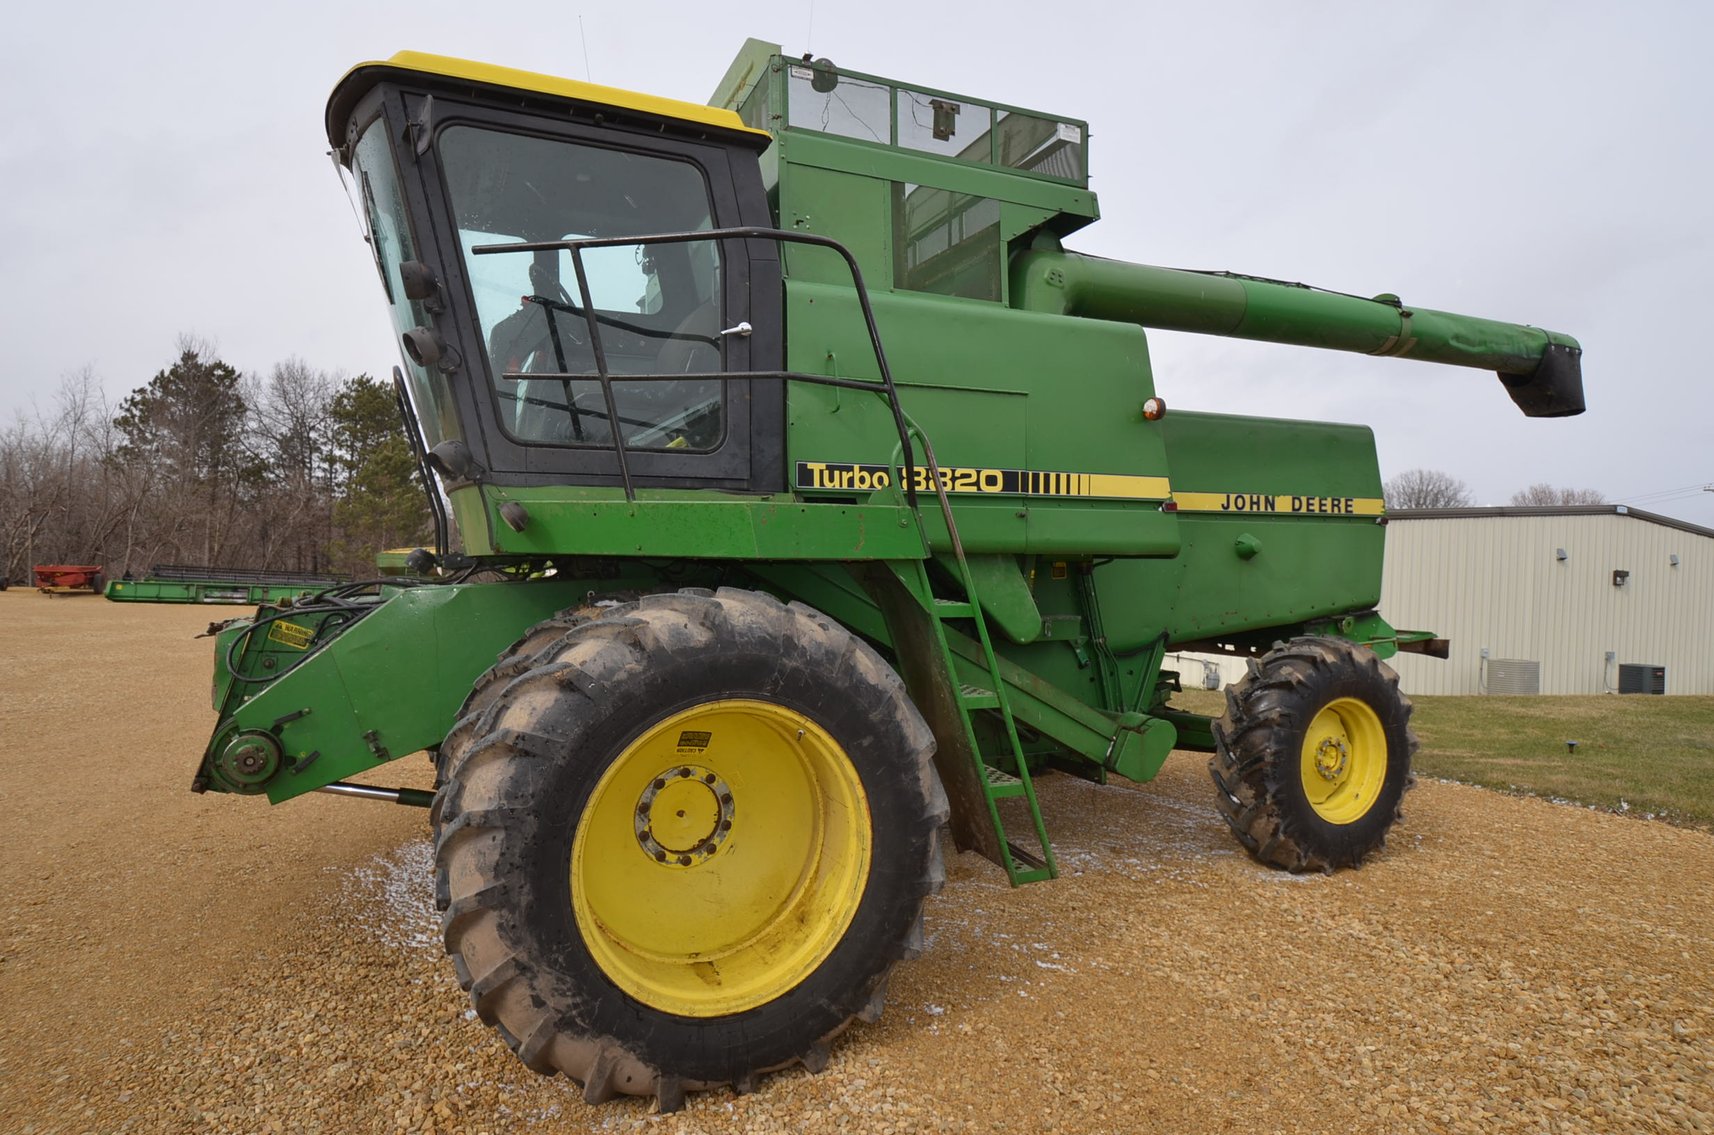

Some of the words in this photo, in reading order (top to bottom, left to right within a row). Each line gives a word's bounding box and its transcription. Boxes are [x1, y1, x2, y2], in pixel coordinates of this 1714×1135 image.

[807, 463, 889, 489] Turbo
[902, 466, 1003, 492] 8820
[1221, 494, 1276, 512] JOHN
[1292, 496, 1354, 513] DEERE
